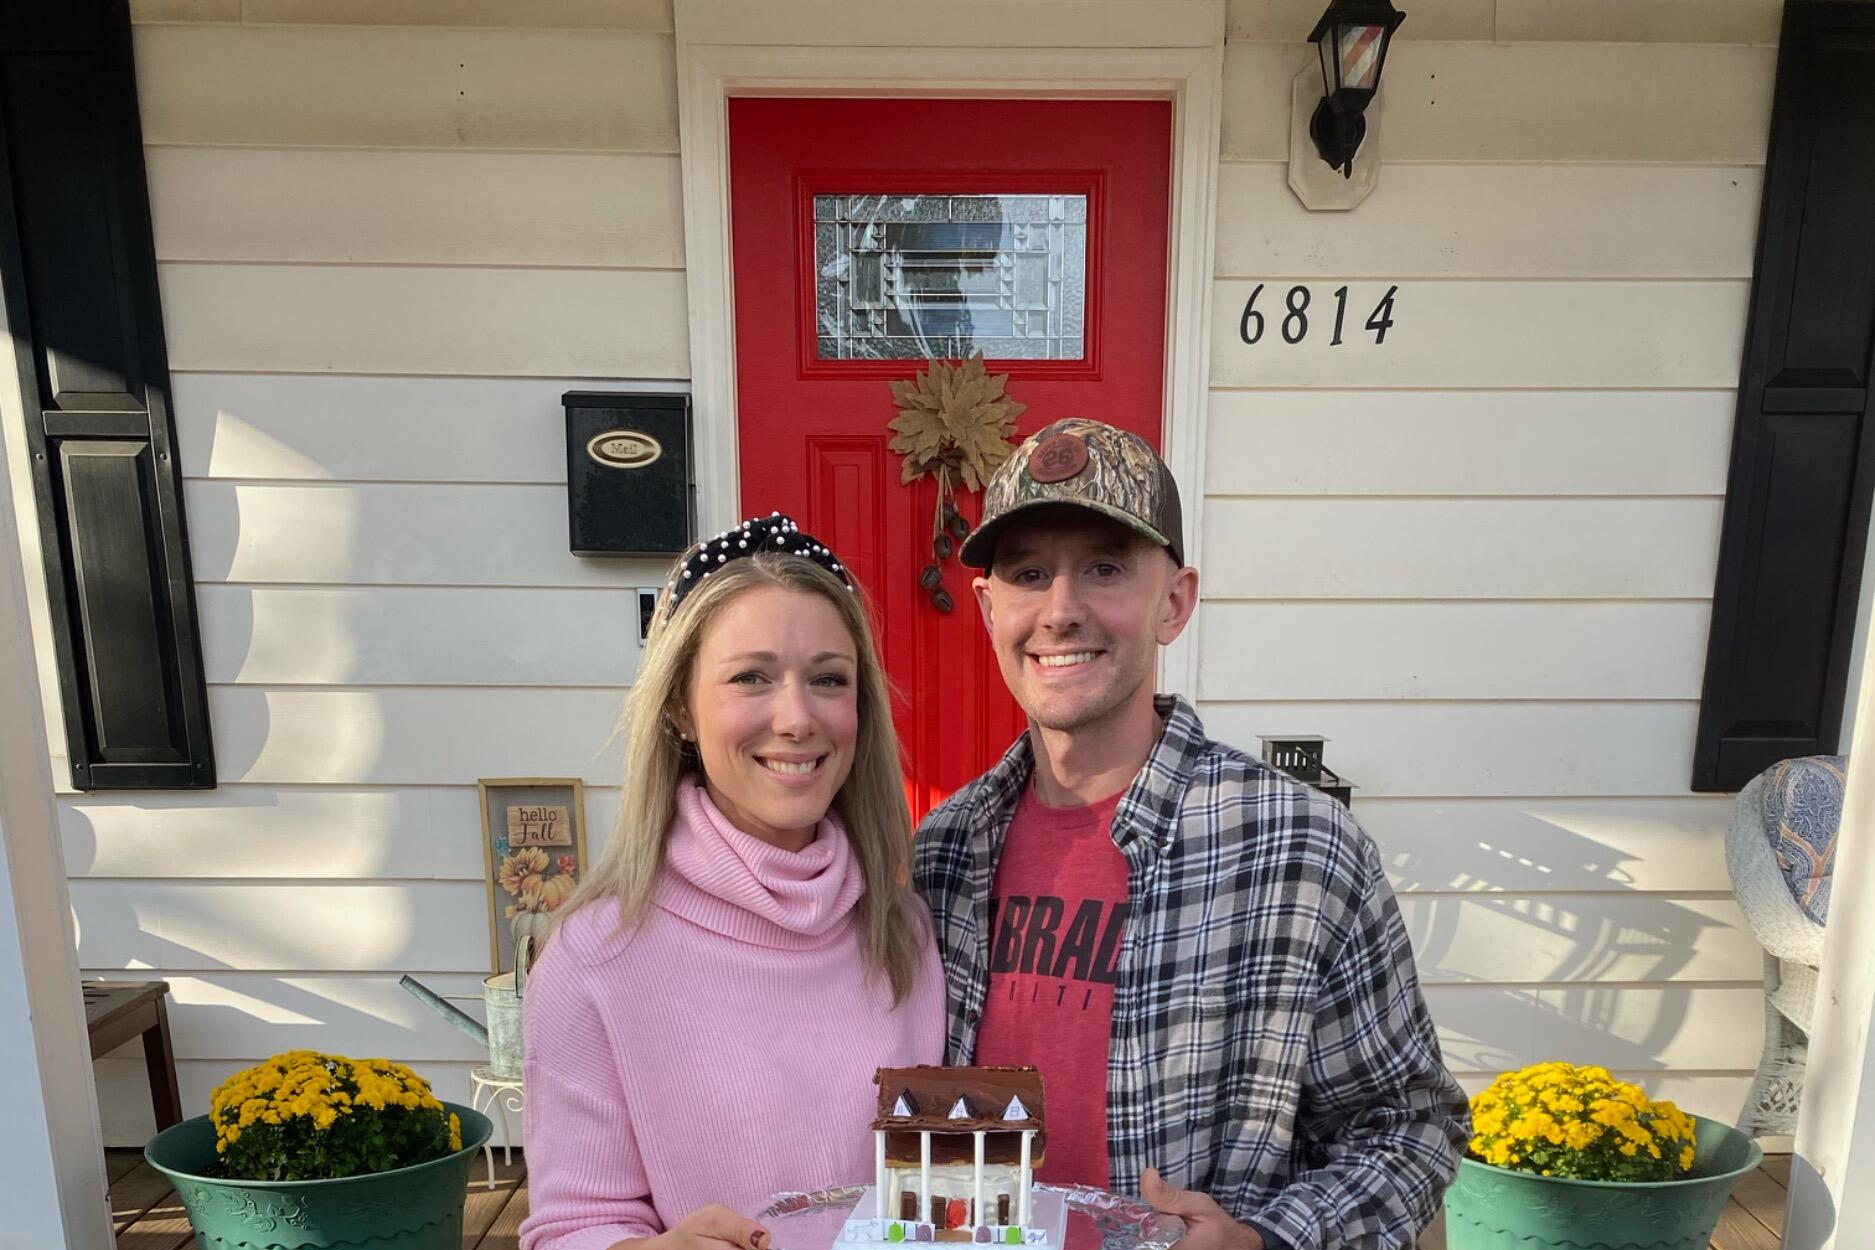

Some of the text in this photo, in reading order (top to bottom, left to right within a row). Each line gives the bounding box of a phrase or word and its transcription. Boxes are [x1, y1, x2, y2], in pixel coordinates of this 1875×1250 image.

[1240, 283, 1398, 346] 6814
[519, 807, 557, 822] hello
[516, 823, 556, 844] Fall
